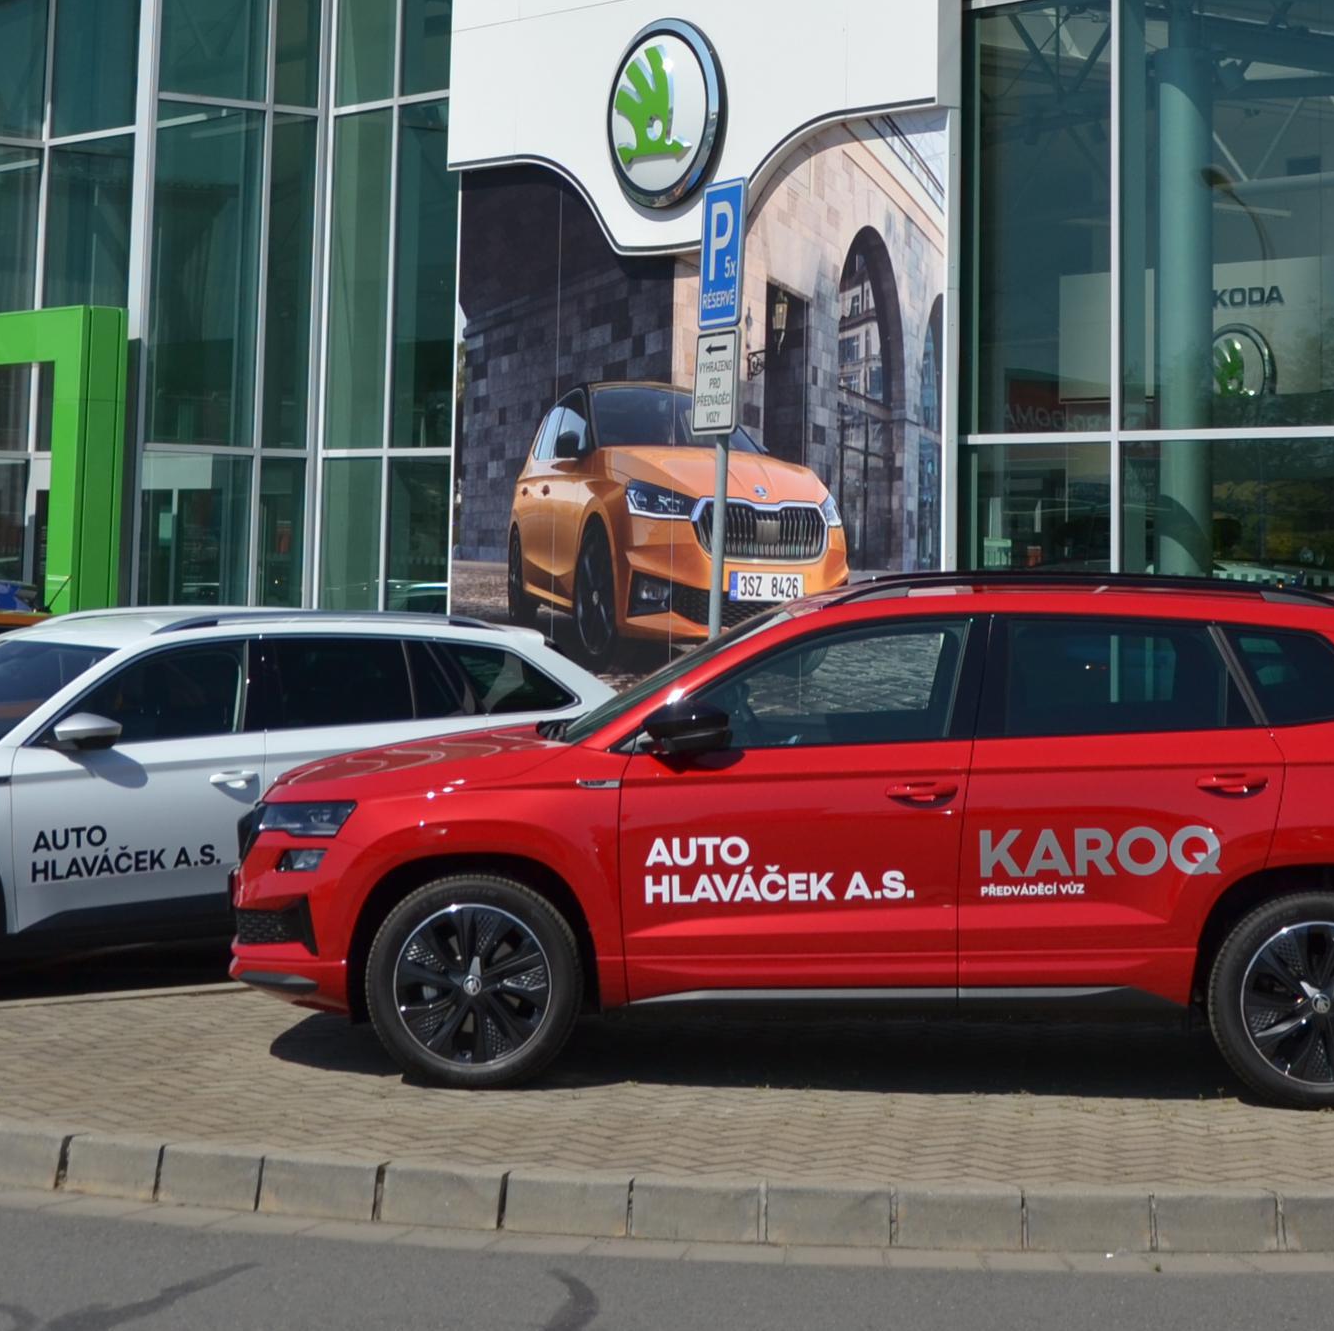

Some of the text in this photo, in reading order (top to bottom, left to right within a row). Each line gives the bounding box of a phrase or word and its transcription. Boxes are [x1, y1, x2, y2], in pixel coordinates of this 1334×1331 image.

[709, 200, 734, 281] P
[724, 256, 736, 278] 5x
[702, 284, 735, 310] RÉSERVÉ
[1211, 285, 1286, 308] KODA
[708, 376, 721, 389] PRO
[705, 410, 721, 423] VOZY
[740, 575, 799, 599] 3SZ 8426
[32, 825, 107, 853] AUTO
[645, 836, 750, 867] AUTO
[979, 825, 1222, 878] KAROQ
[31, 844, 221, 883] HLAVÁČEK A.S.
[644, 865, 915, 904] HLAVÁČEK A.S.
[980, 881, 1085, 897] PŘEDVÁDĚCÍ VŮZ
